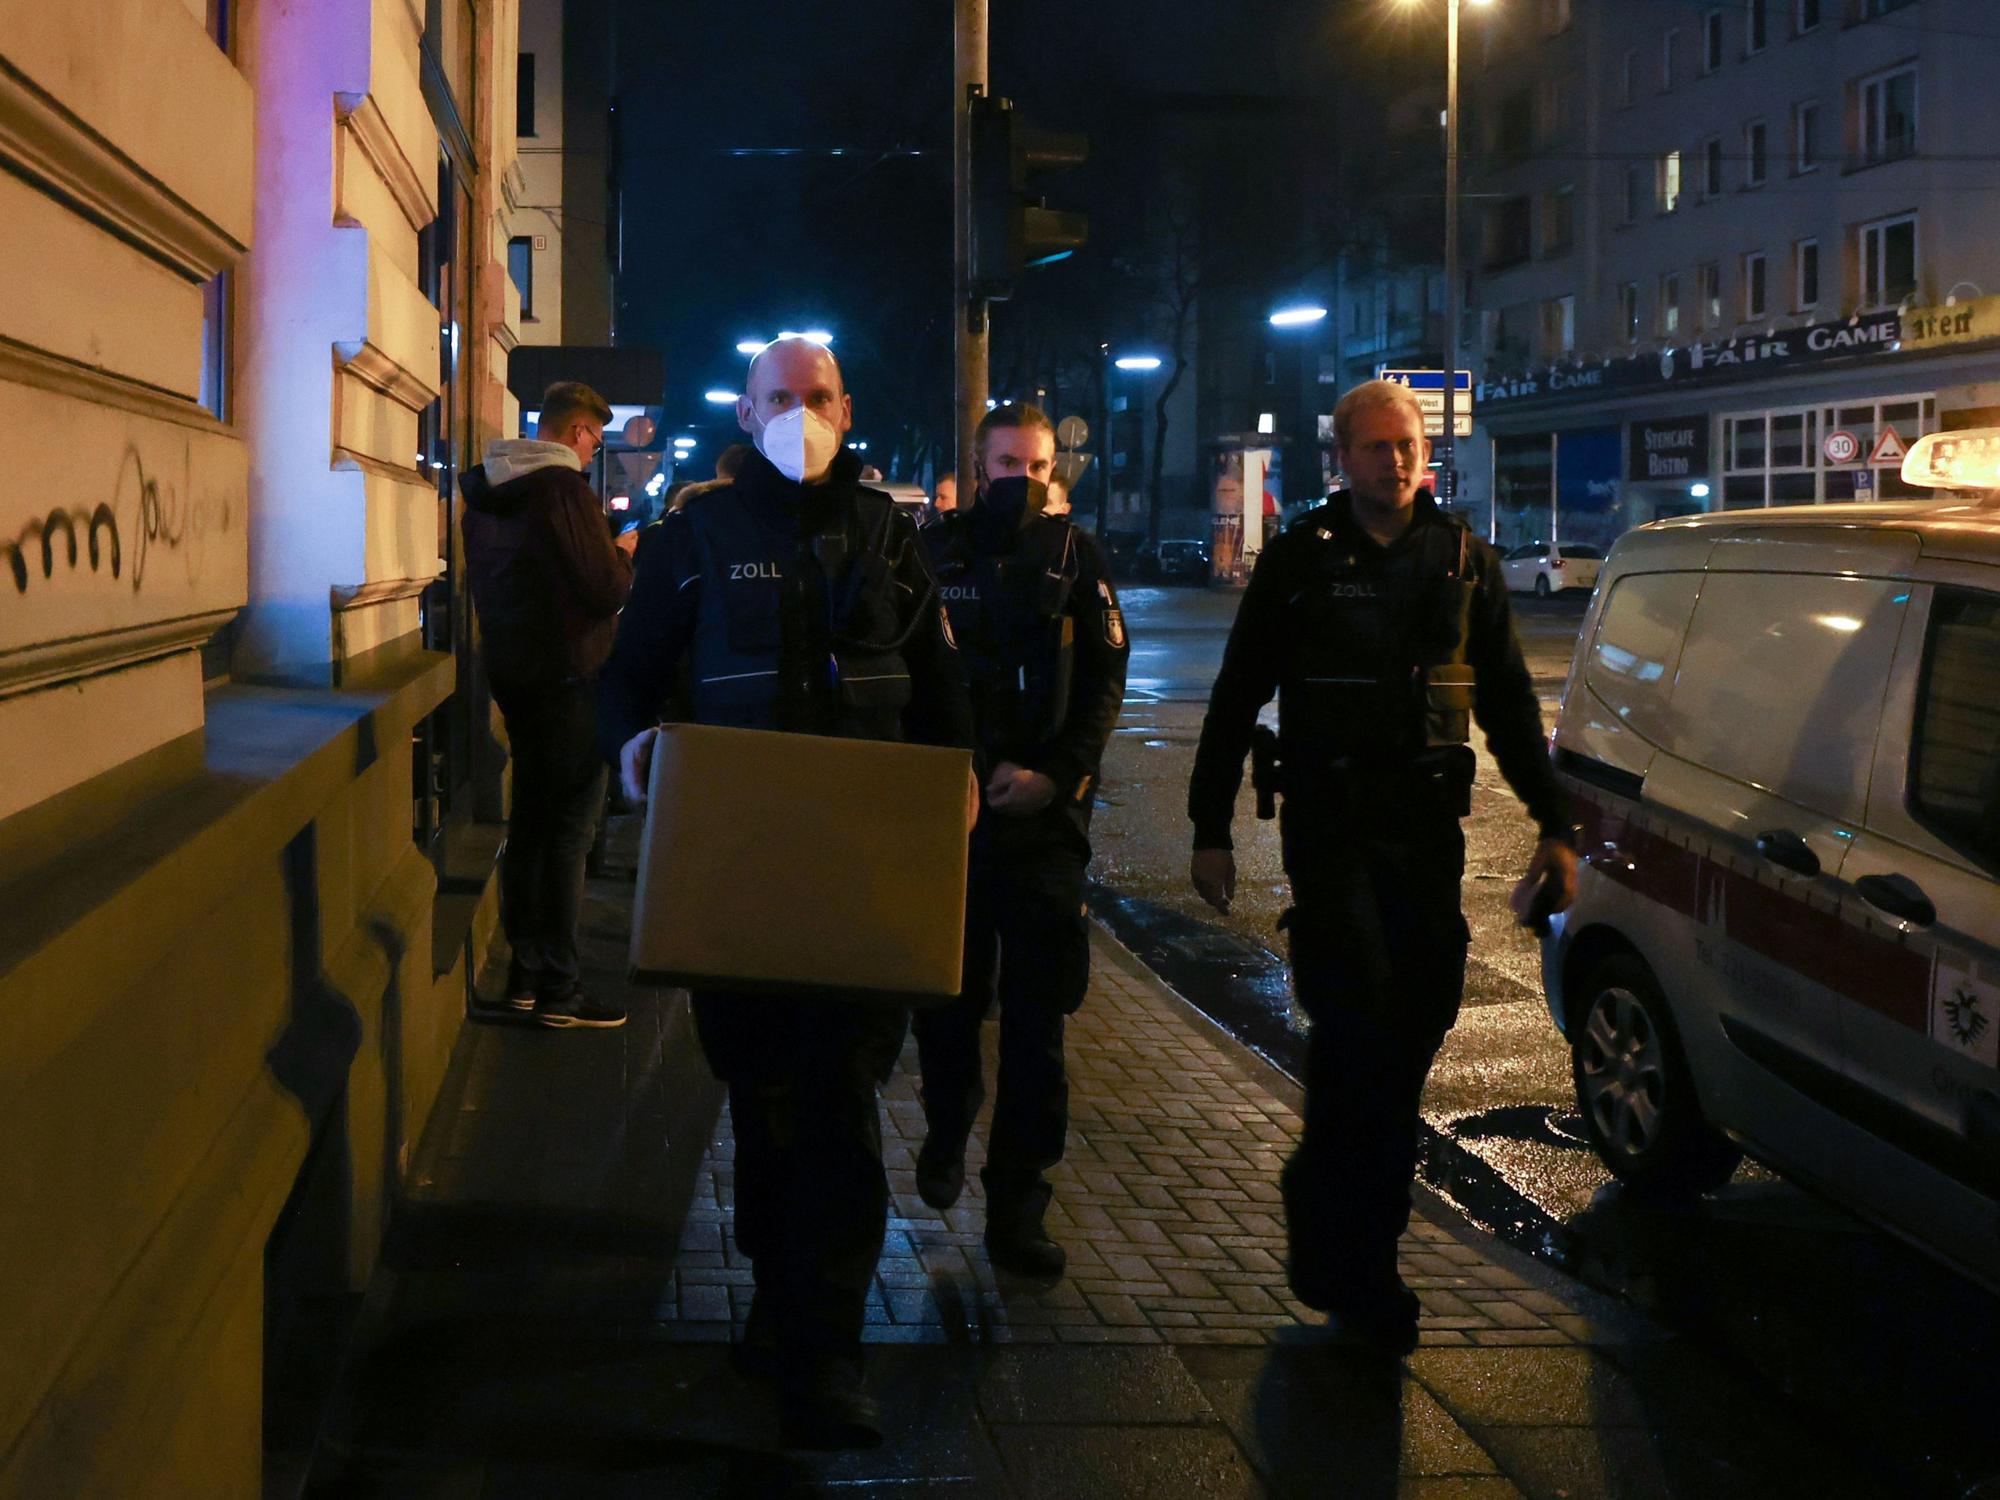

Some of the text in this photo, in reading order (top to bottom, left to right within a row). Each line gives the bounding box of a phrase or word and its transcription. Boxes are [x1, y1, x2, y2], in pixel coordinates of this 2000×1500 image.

[1807, 322, 1896, 351] GAME
[1833, 439, 1851, 454] 30
[1649, 453, 1689, 476] BISTRO
[1857, 471, 1868, 488] P
[730, 562, 783, 580] ZOLL
[940, 585, 981, 600] ZOLL
[1331, 583, 1377, 599] ZOLL
